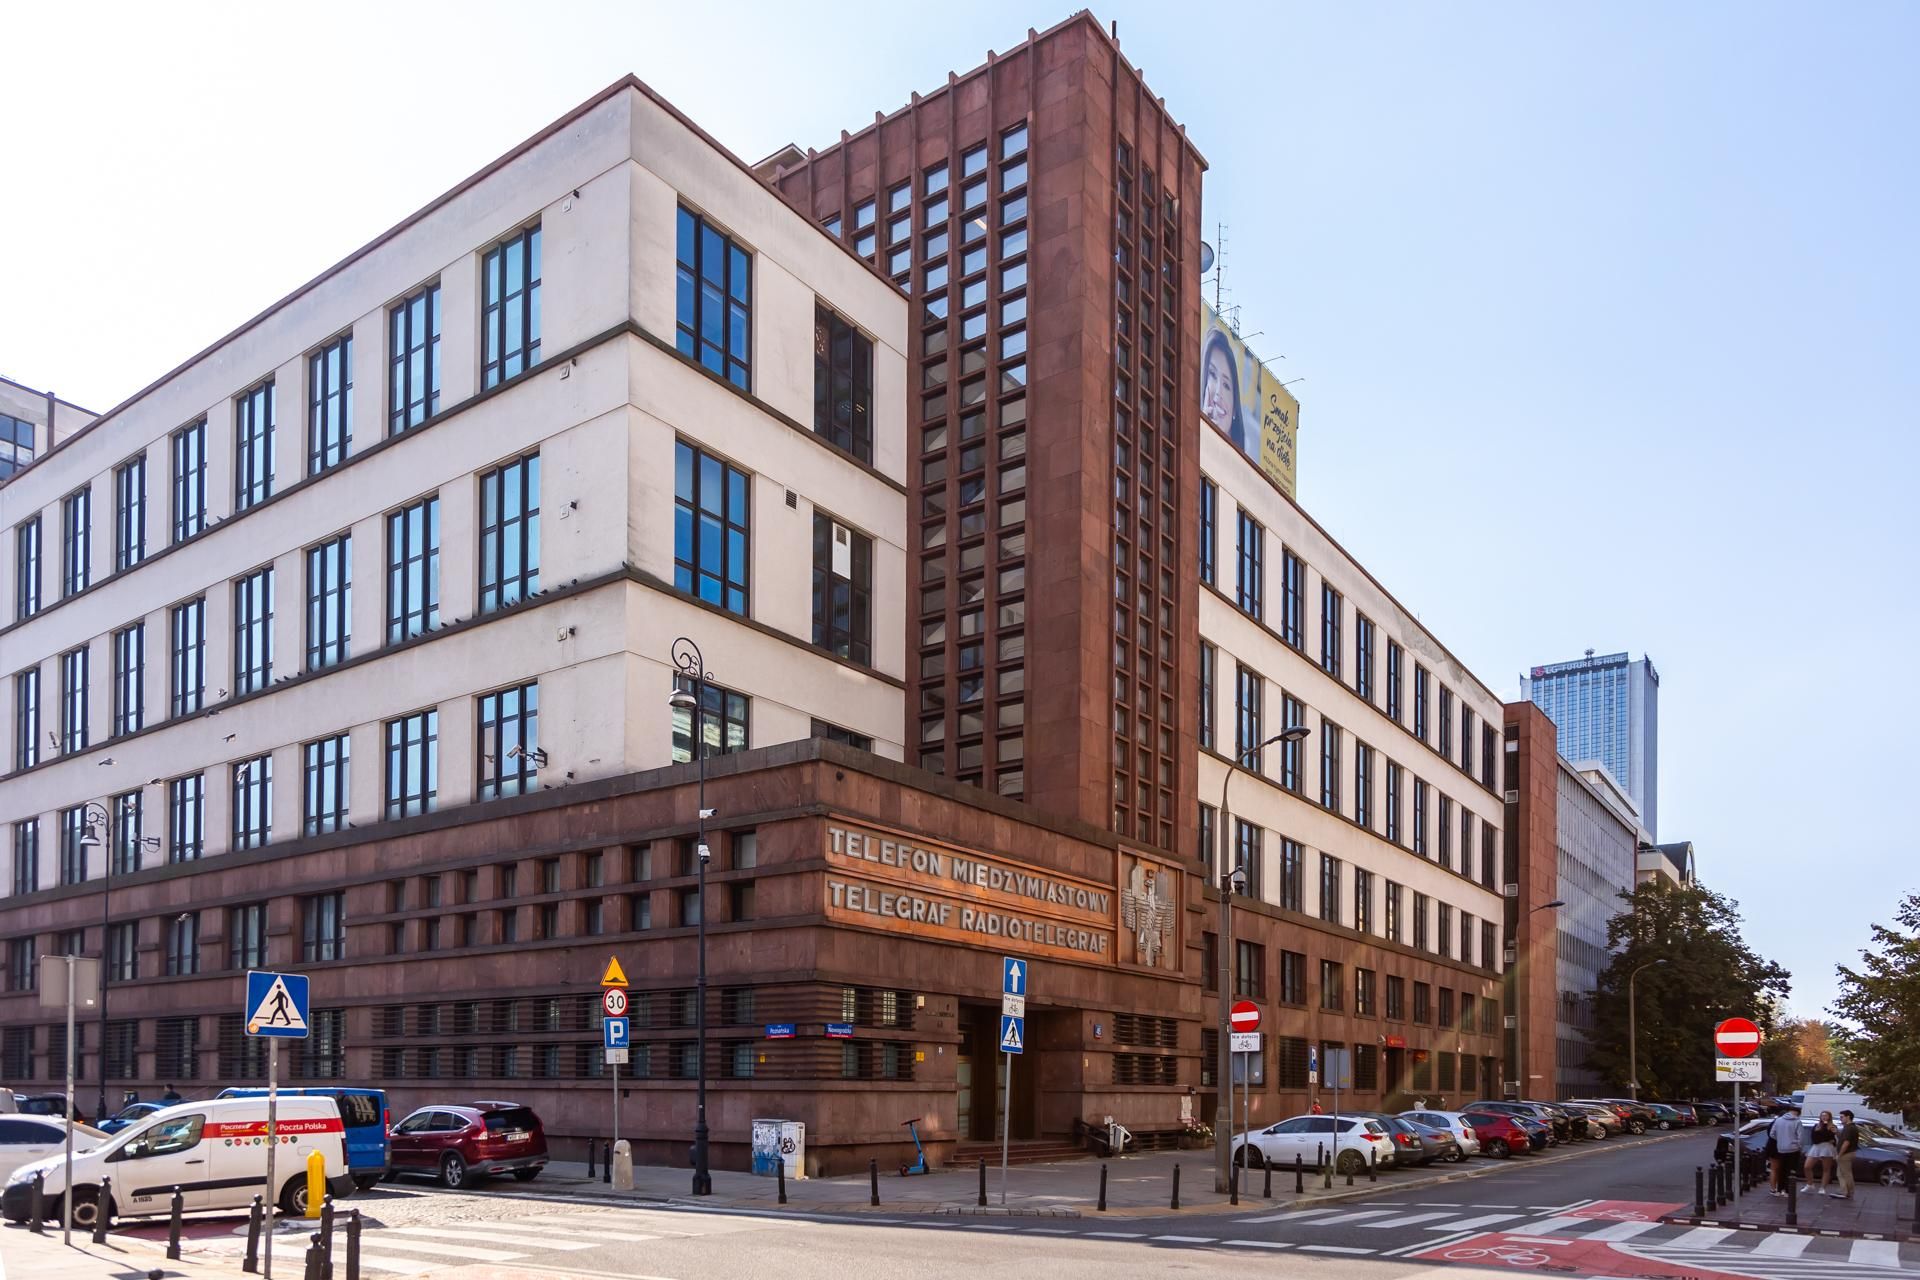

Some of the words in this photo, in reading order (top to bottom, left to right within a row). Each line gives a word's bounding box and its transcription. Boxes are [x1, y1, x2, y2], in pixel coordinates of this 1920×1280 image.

[829, 827, 942, 876] TELEFON
[952, 858, 1109, 914] MIĘDZYMIASTOWY
[829, 880, 952, 925] TELEGRAF
[961, 908, 1108, 953] RADIOTELEGRAF
[607, 995, 625, 1009] 30
[609, 1021, 624, 1045] P
[304, 1122, 327, 1130] Polska
